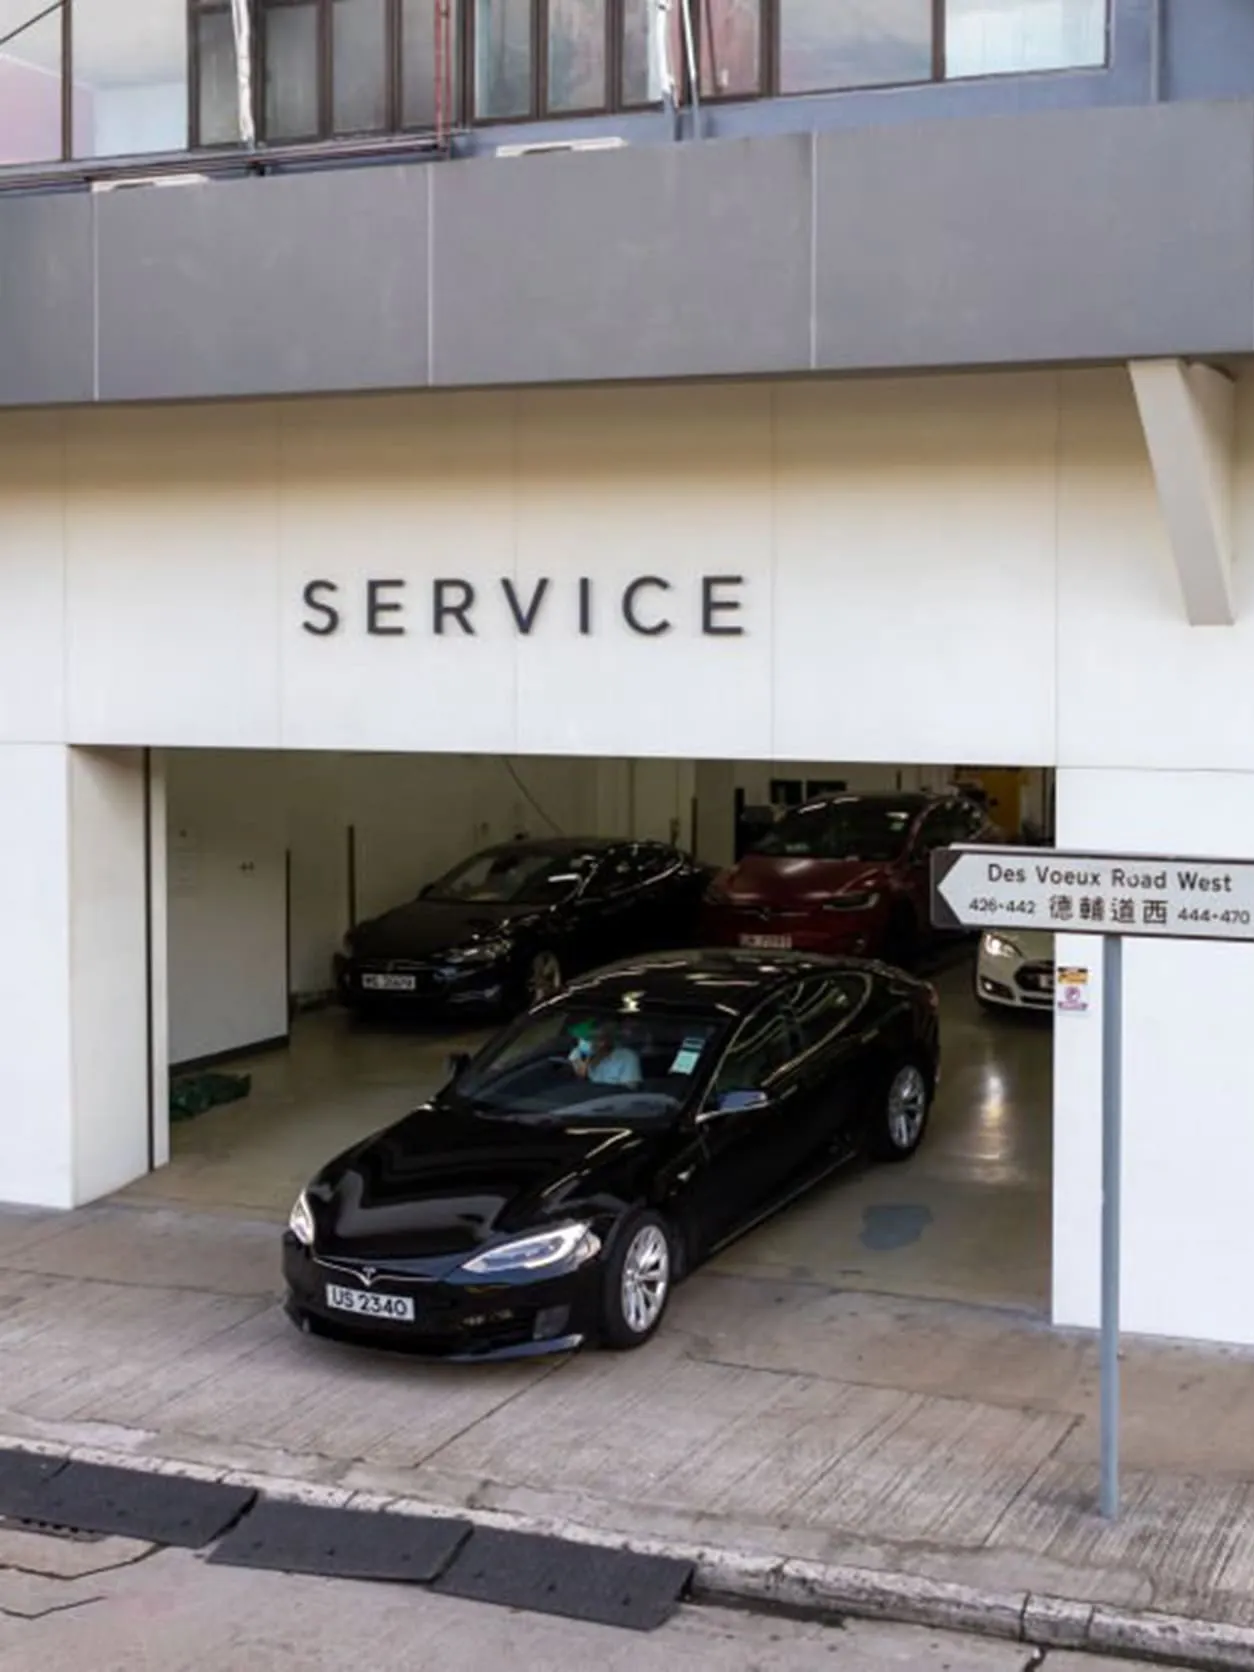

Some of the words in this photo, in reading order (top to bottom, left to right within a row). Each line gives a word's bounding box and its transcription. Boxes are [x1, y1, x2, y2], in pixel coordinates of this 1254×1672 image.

[303, 576, 744, 636] SERVICE
[987, 863, 1026, 883] Des
[1035, 865, 1101, 886] Voeux
[1111, 868, 1167, 890] Road
[1177, 871, 1232, 893] West
[968, 897, 1036, 915] 426-442
[1049, 894, 1168, 925] 德輔道西
[1177, 907, 1250, 925] 444-470
[332, 1287, 354, 1307] US
[359, 1294, 407, 1316] 2340
